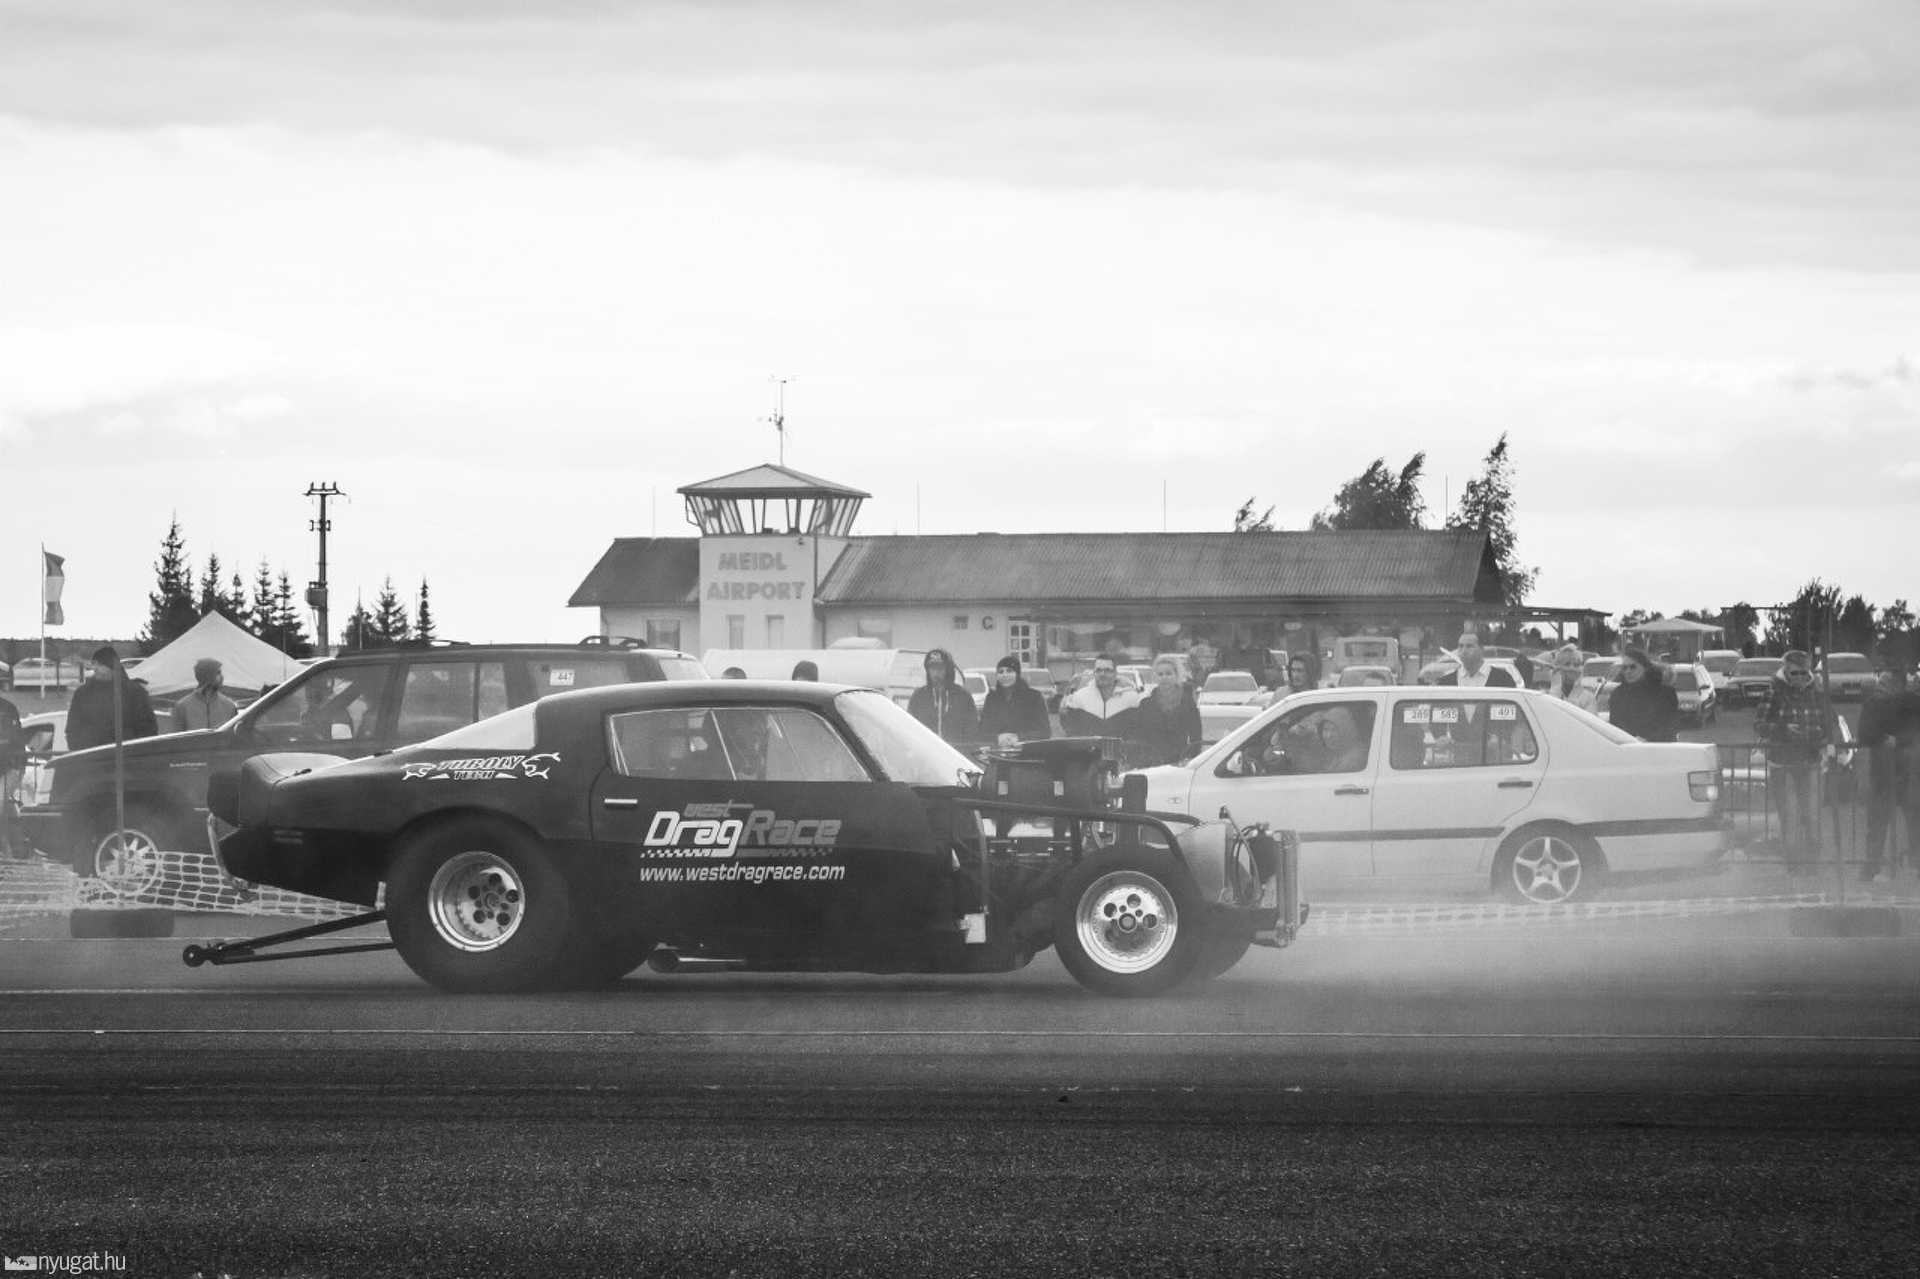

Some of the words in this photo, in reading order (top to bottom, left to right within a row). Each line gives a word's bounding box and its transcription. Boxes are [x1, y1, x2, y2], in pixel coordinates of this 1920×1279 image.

[718, 552, 788, 571] MEIDL
[707, 582, 806, 600] AIRPORT
[453, 770, 496, 781] TECH
[643, 810, 744, 858] Drag
[740, 809, 842, 845] Race
[639, 861, 846, 884] www.westdragrace.com
